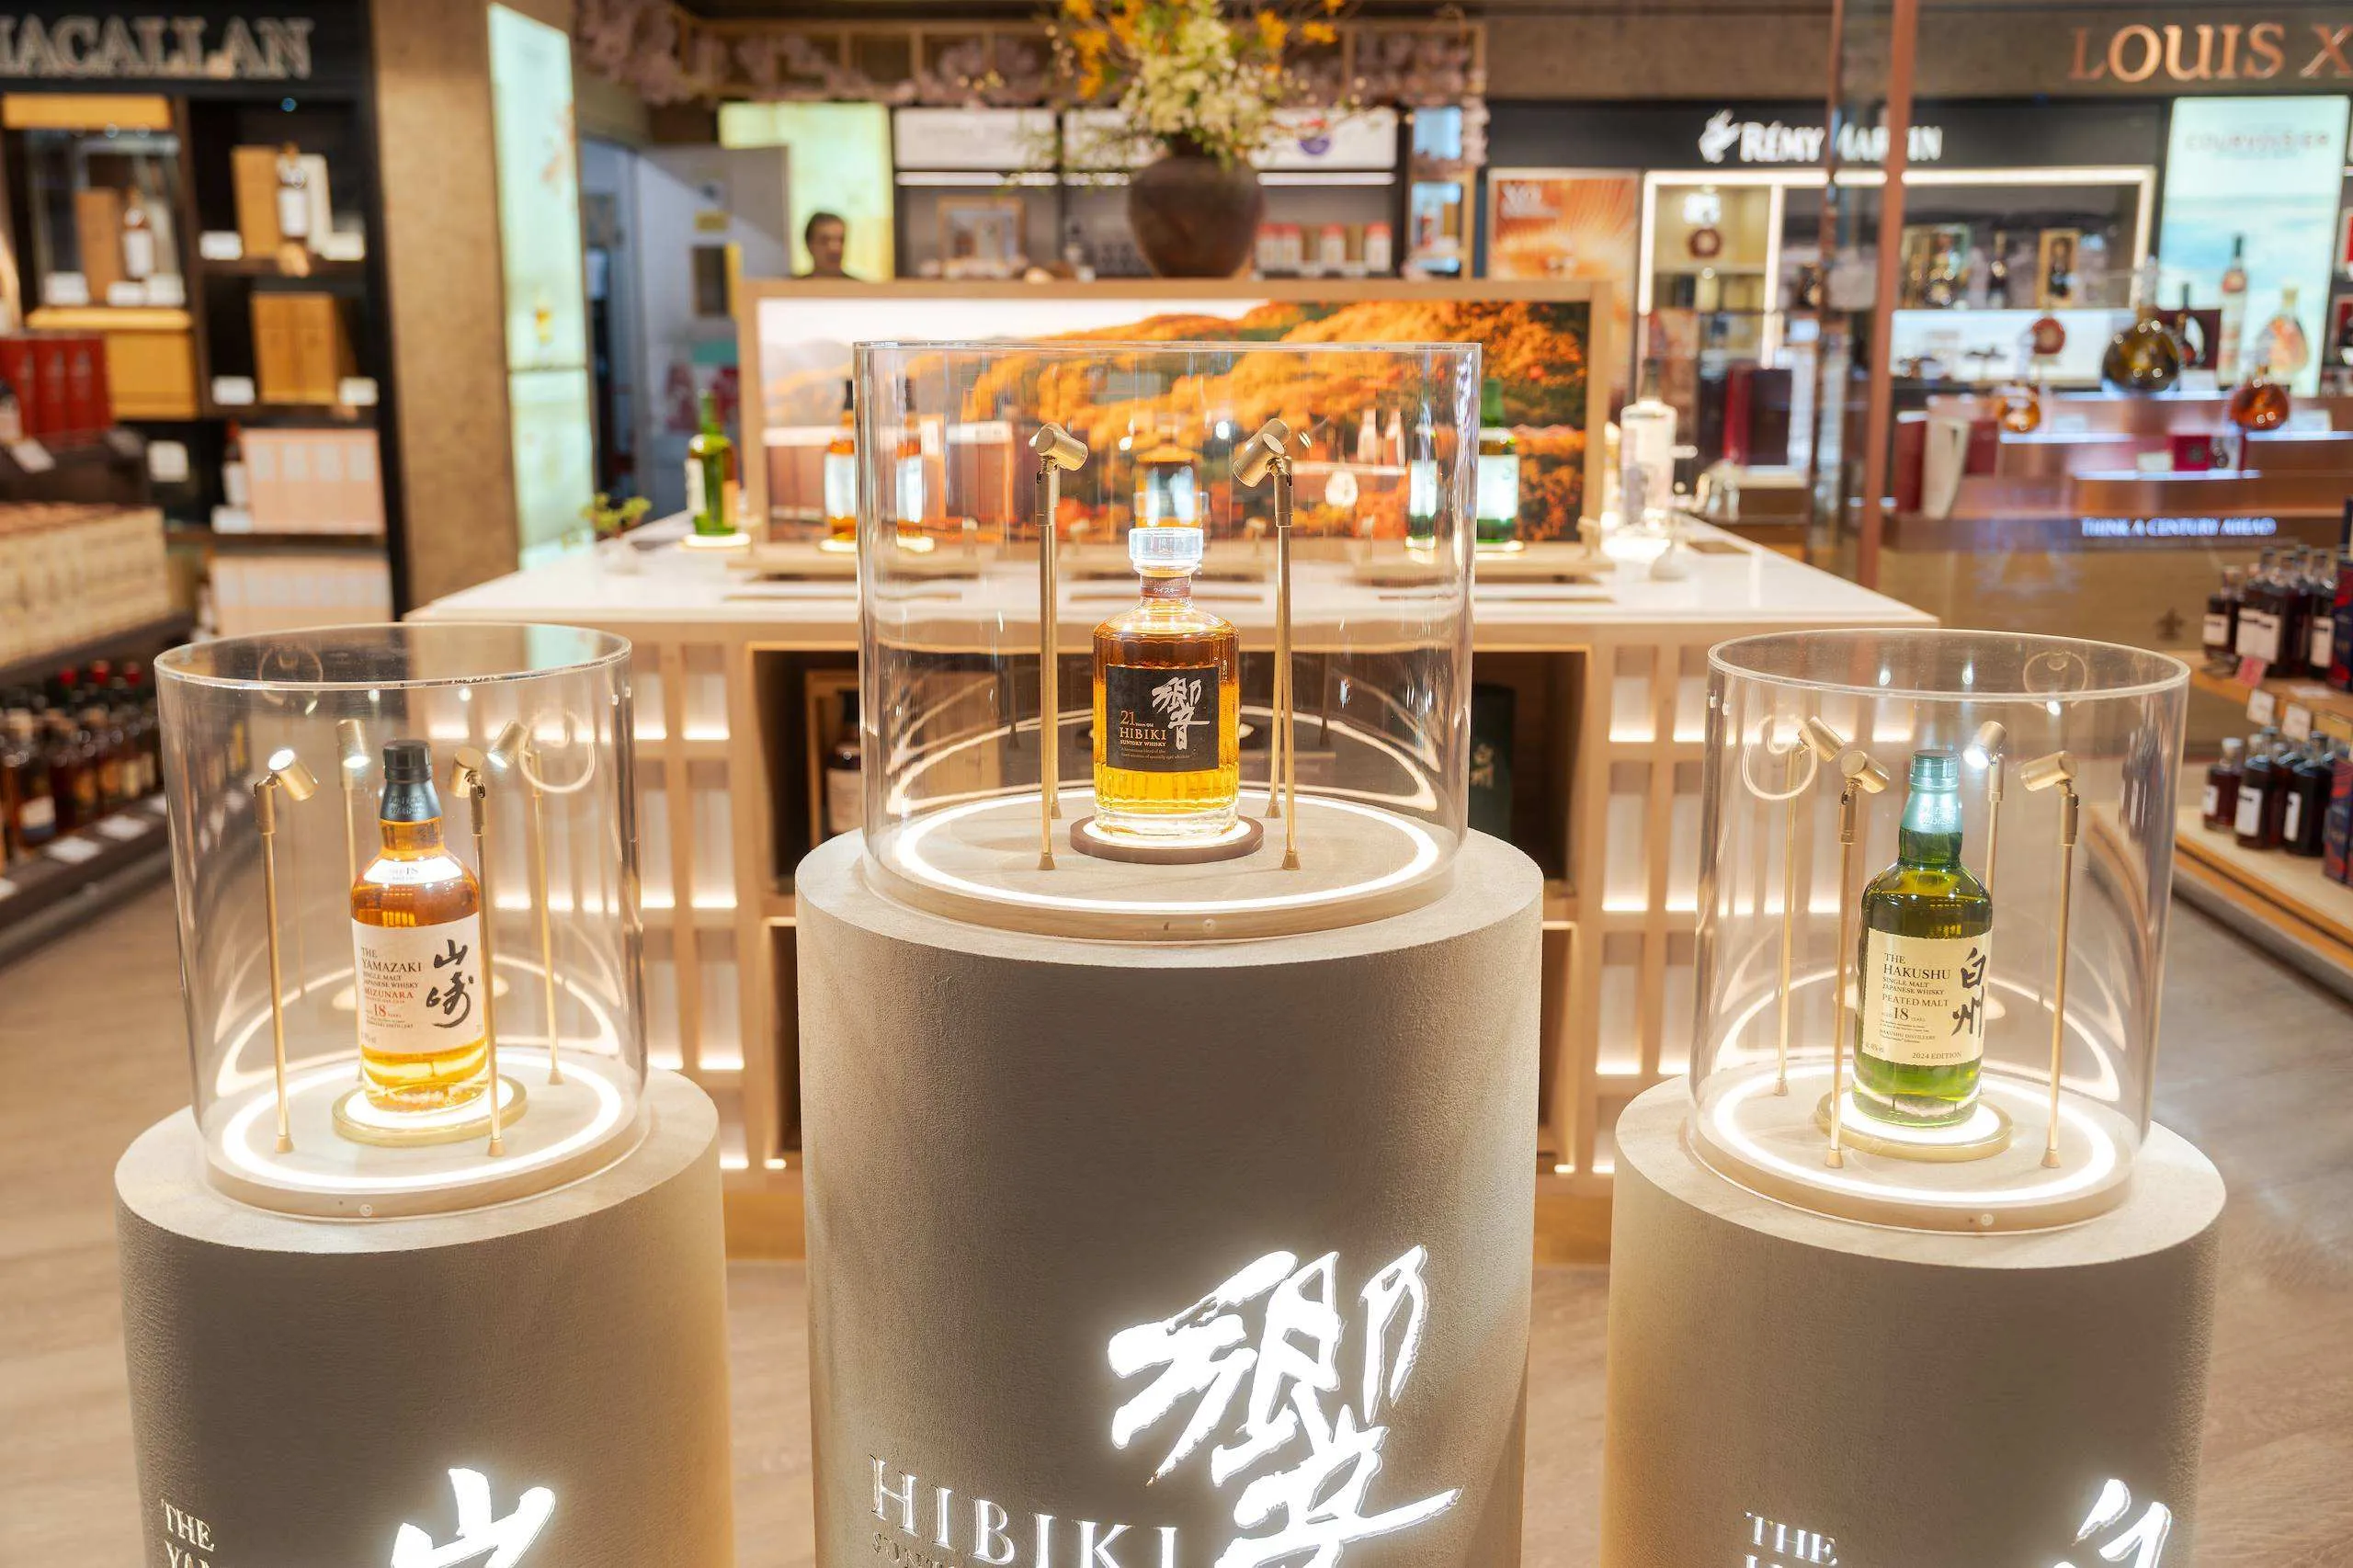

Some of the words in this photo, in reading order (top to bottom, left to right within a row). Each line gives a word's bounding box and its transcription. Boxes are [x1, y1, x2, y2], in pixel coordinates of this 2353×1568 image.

[2068, 23, 2286, 83] LOUIS
[1120, 710, 1134, 724] 21
[1152, 676, 1211, 750] 響
[1120, 726, 1166, 740] HIBIKI
[361, 947, 377, 959] THE
[1884, 952, 1905, 964] THE
[361, 958, 423, 972] YAMAZAKI
[1883, 963, 1950, 980] HAKUSHU
[1882, 977, 1907, 986] SINGLE
[1882, 983, 1915, 994] JAPANESE
[365, 987, 414, 999] MIZUNARA
[1951, 947, 1986, 1038] 白州
[1882, 994, 1920, 1006] PEATED
[1921, 999, 1949, 1007] MALT
[374, 1004, 387, 1017] 18
[1893, 1006, 1909, 1020] 18
[1931, 1051, 1962, 1060] EDITION
[869, 1452, 1179, 1568] HIBIKI
[161, 1497, 215, 1552] THE
[1743, 1510, 1838, 1567] THE
